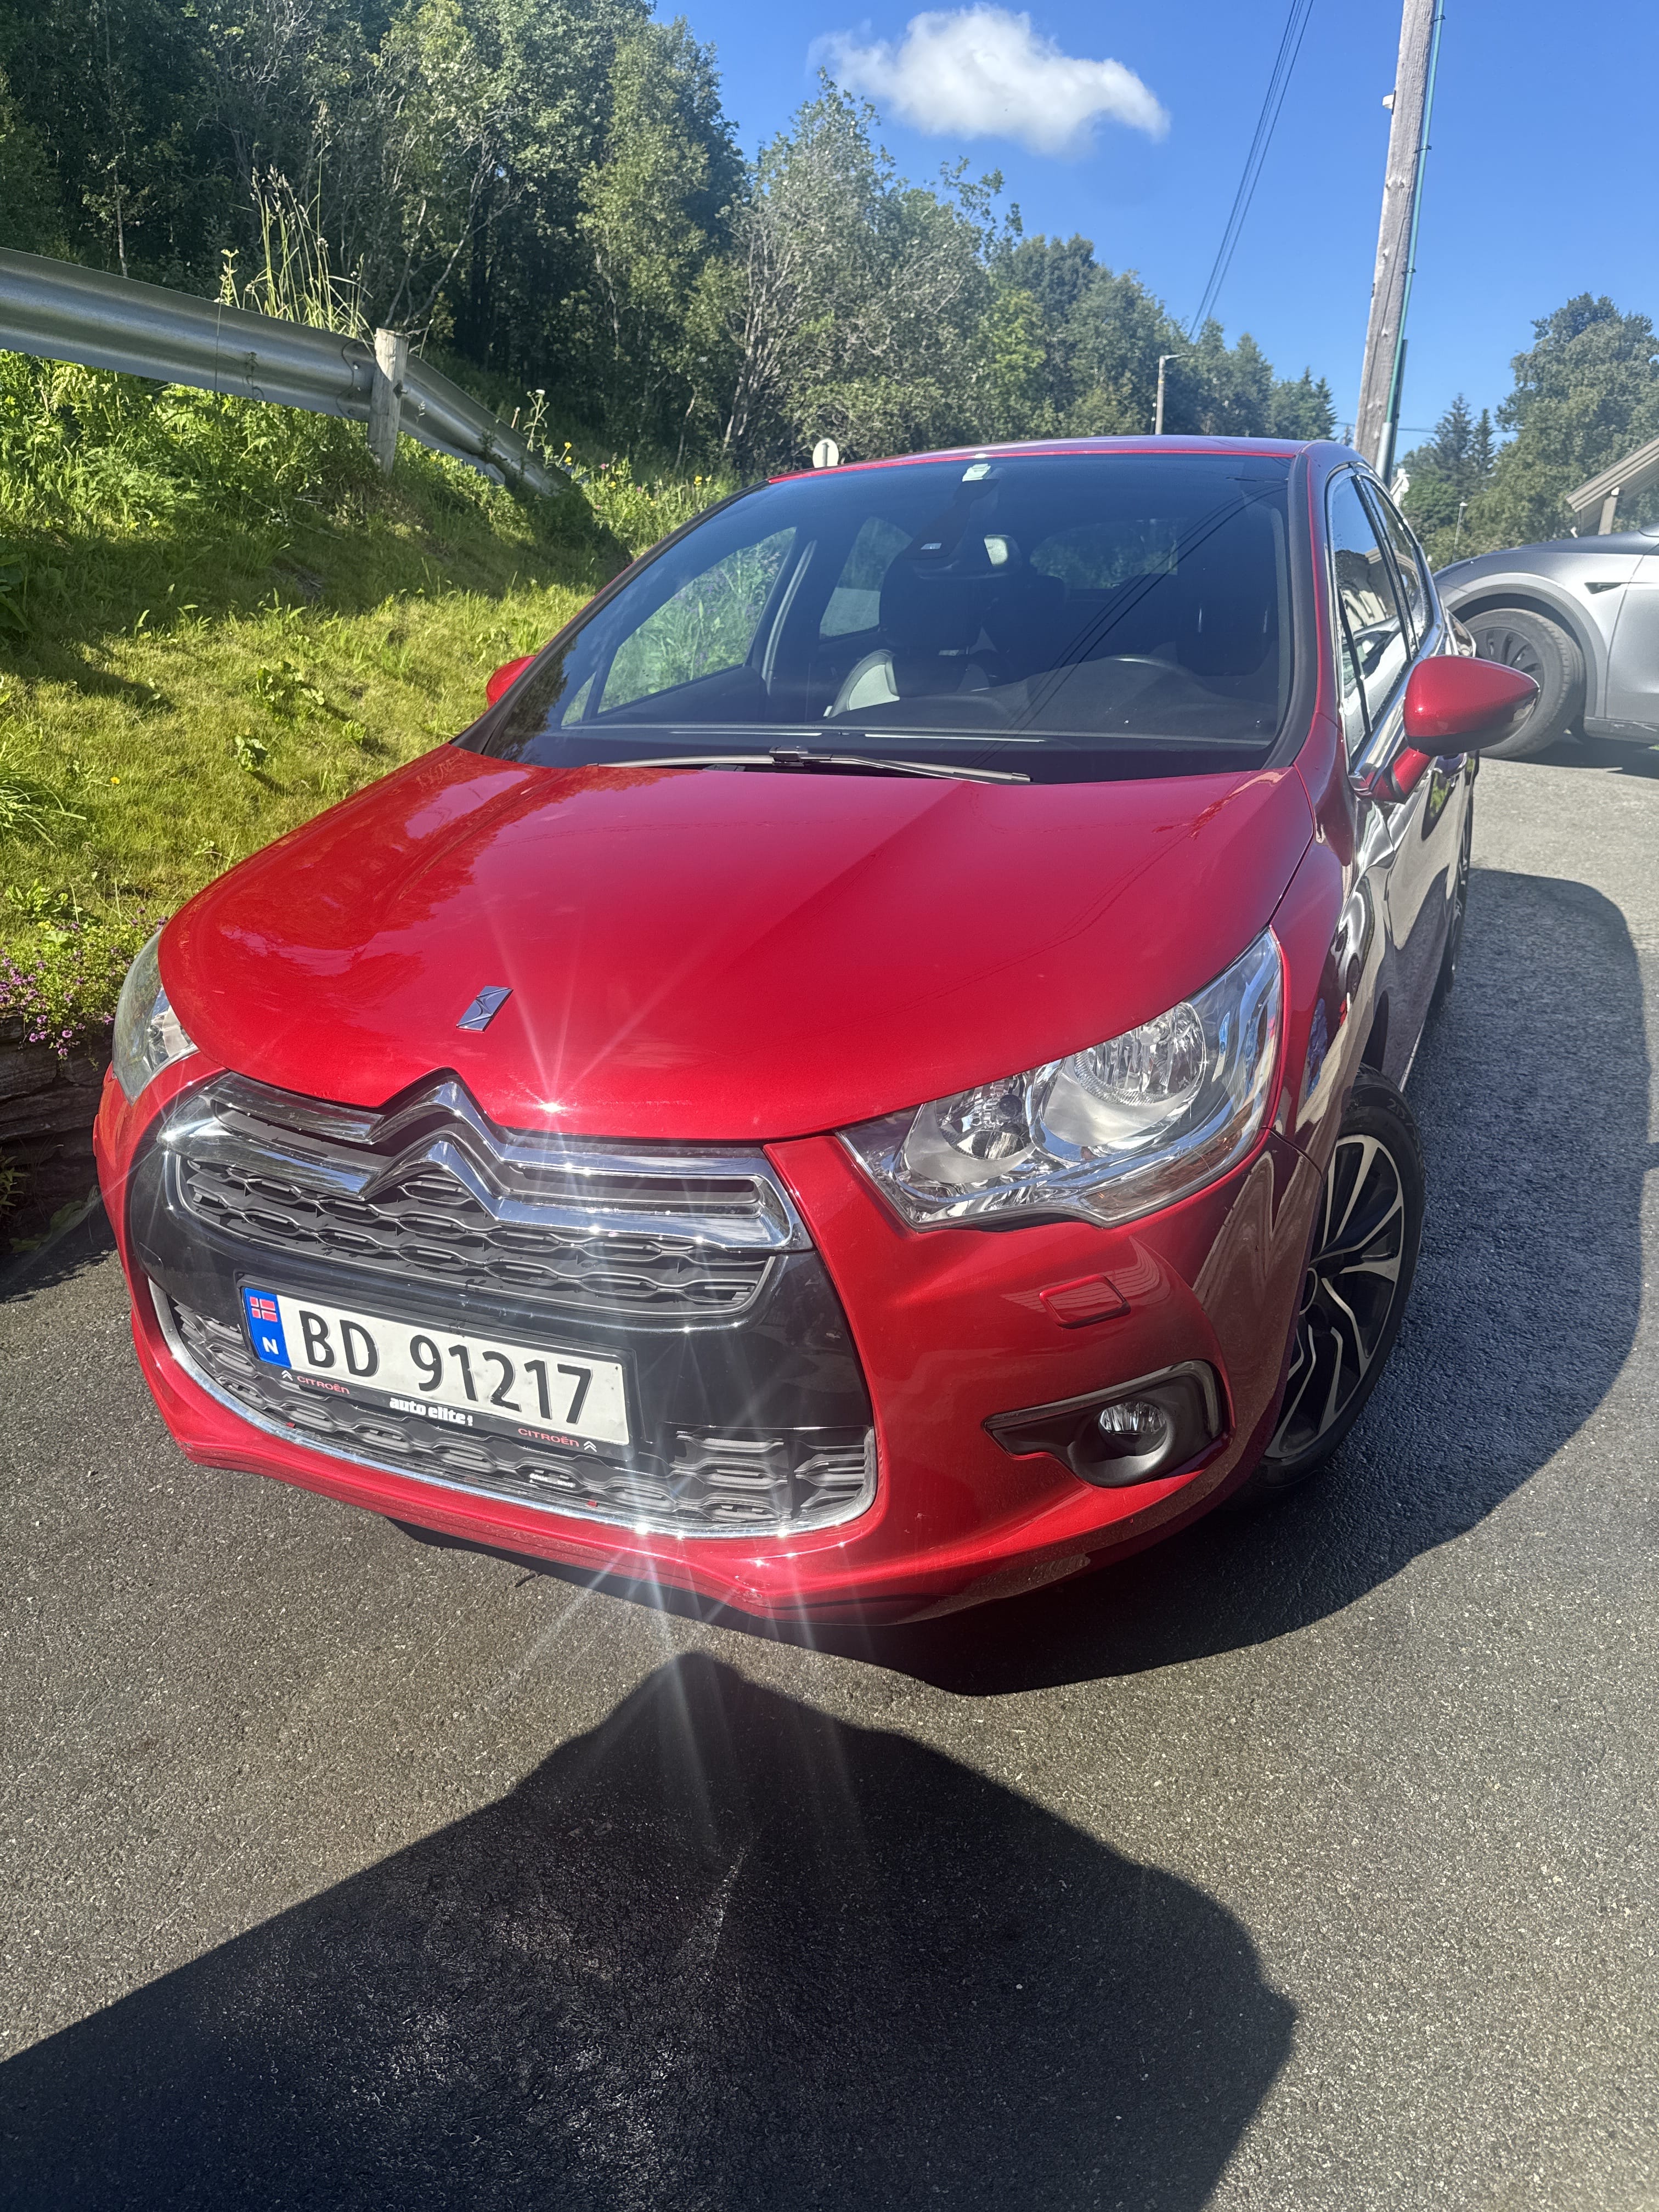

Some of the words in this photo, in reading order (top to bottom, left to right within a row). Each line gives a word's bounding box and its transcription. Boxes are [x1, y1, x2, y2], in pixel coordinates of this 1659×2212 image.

[262, 1337, 279, 1355] N
[298, 1310, 380, 1378] BD
[409, 1334, 593, 1424] 91217
[390, 1397, 426, 1416] auto
[428, 1406, 466, 1425] elite
